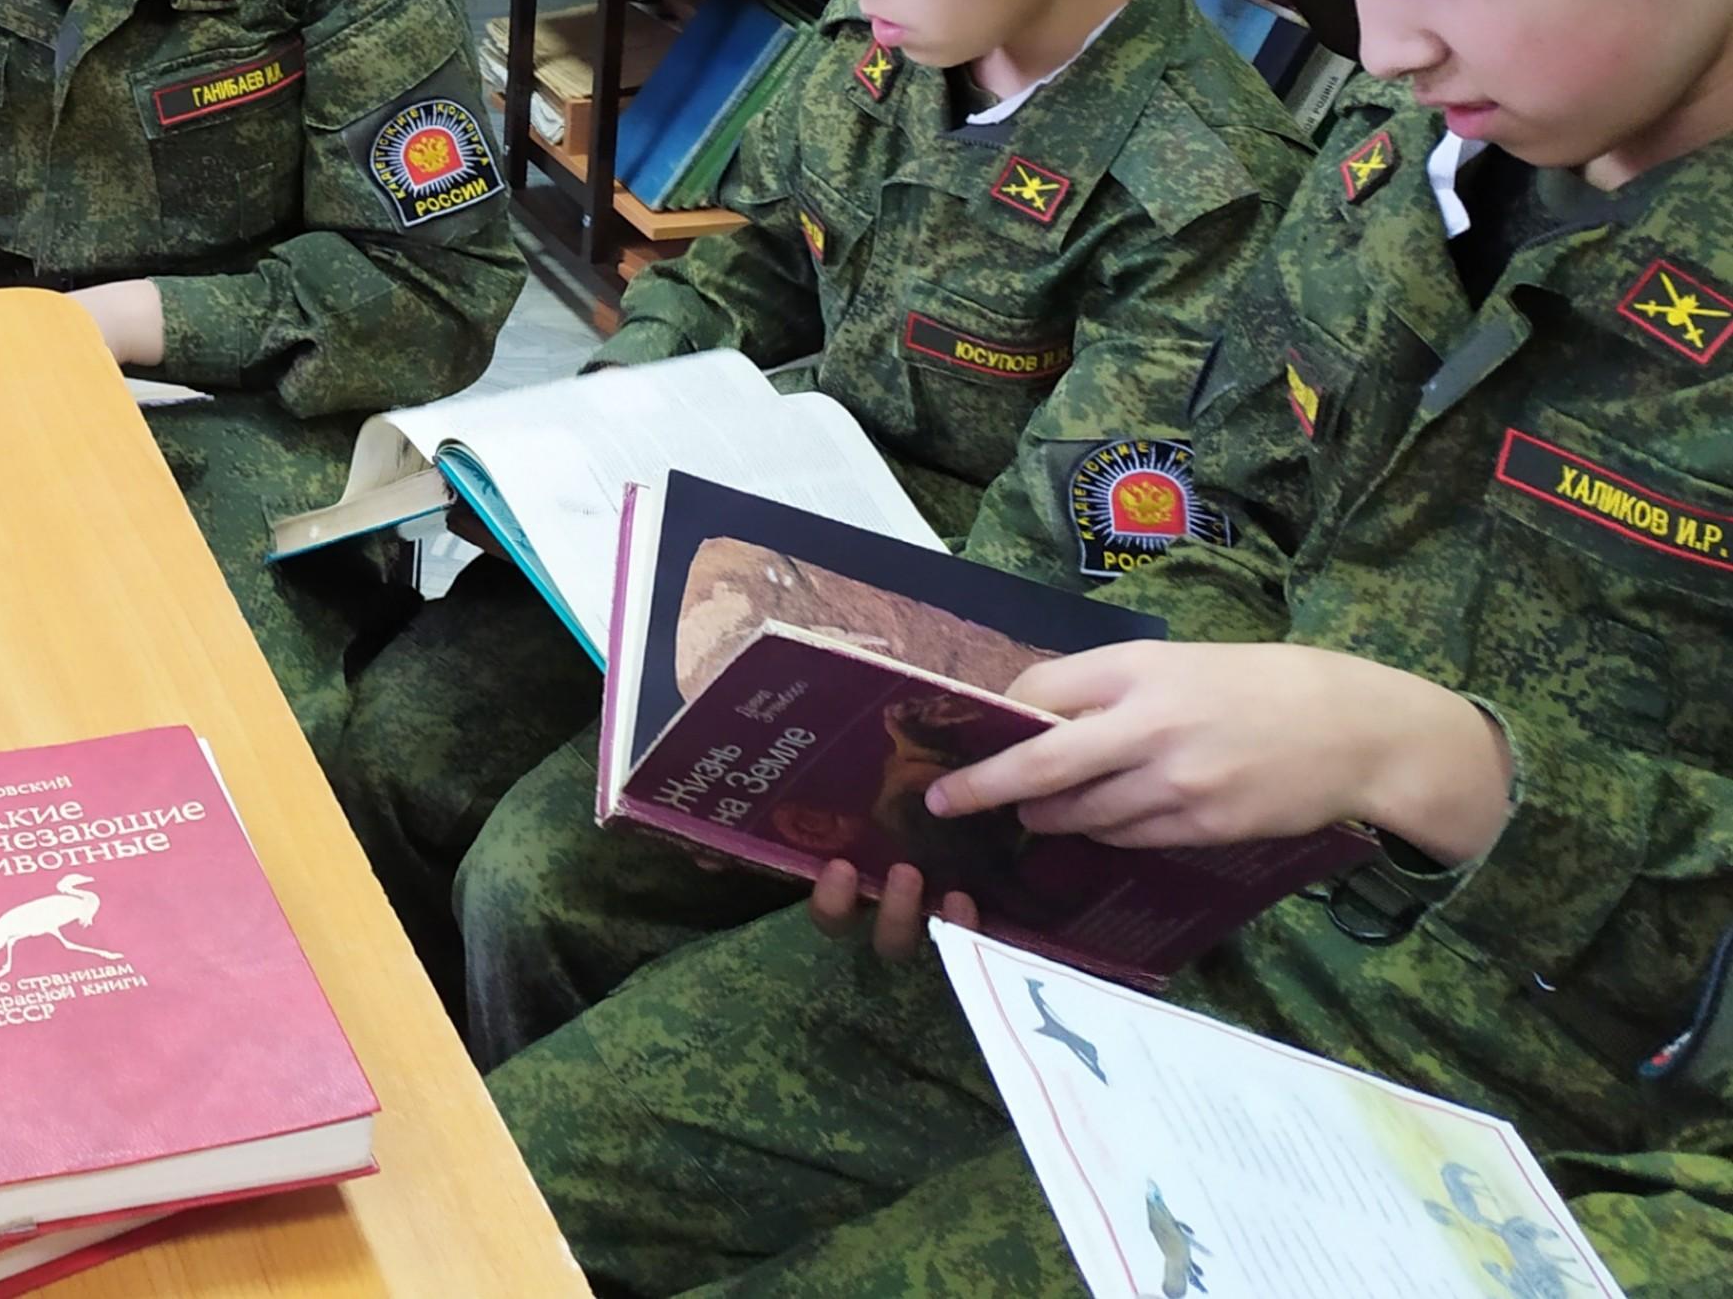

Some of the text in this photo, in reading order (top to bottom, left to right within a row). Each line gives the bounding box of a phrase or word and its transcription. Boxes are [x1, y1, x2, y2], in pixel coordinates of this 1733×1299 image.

[192, 69, 266, 107] ГАНИБАЕВ
[375, 103, 491, 200] КАДЕТСКИЕ КОРПУСА
[415, 177, 489, 217] РОССИИ
[955, 340, 1038, 372] ЮСУПОВ
[1073, 441, 1150, 541] КАДЕТСКИЕ
[1556, 464, 1729, 559] ХАЛИКОВ И.Р.
[652, 744, 743, 814] Жизнь
[709, 726, 817, 828] на Земле
[15, 962, 135, 995] страницам
[81, 975, 149, 999] книги
